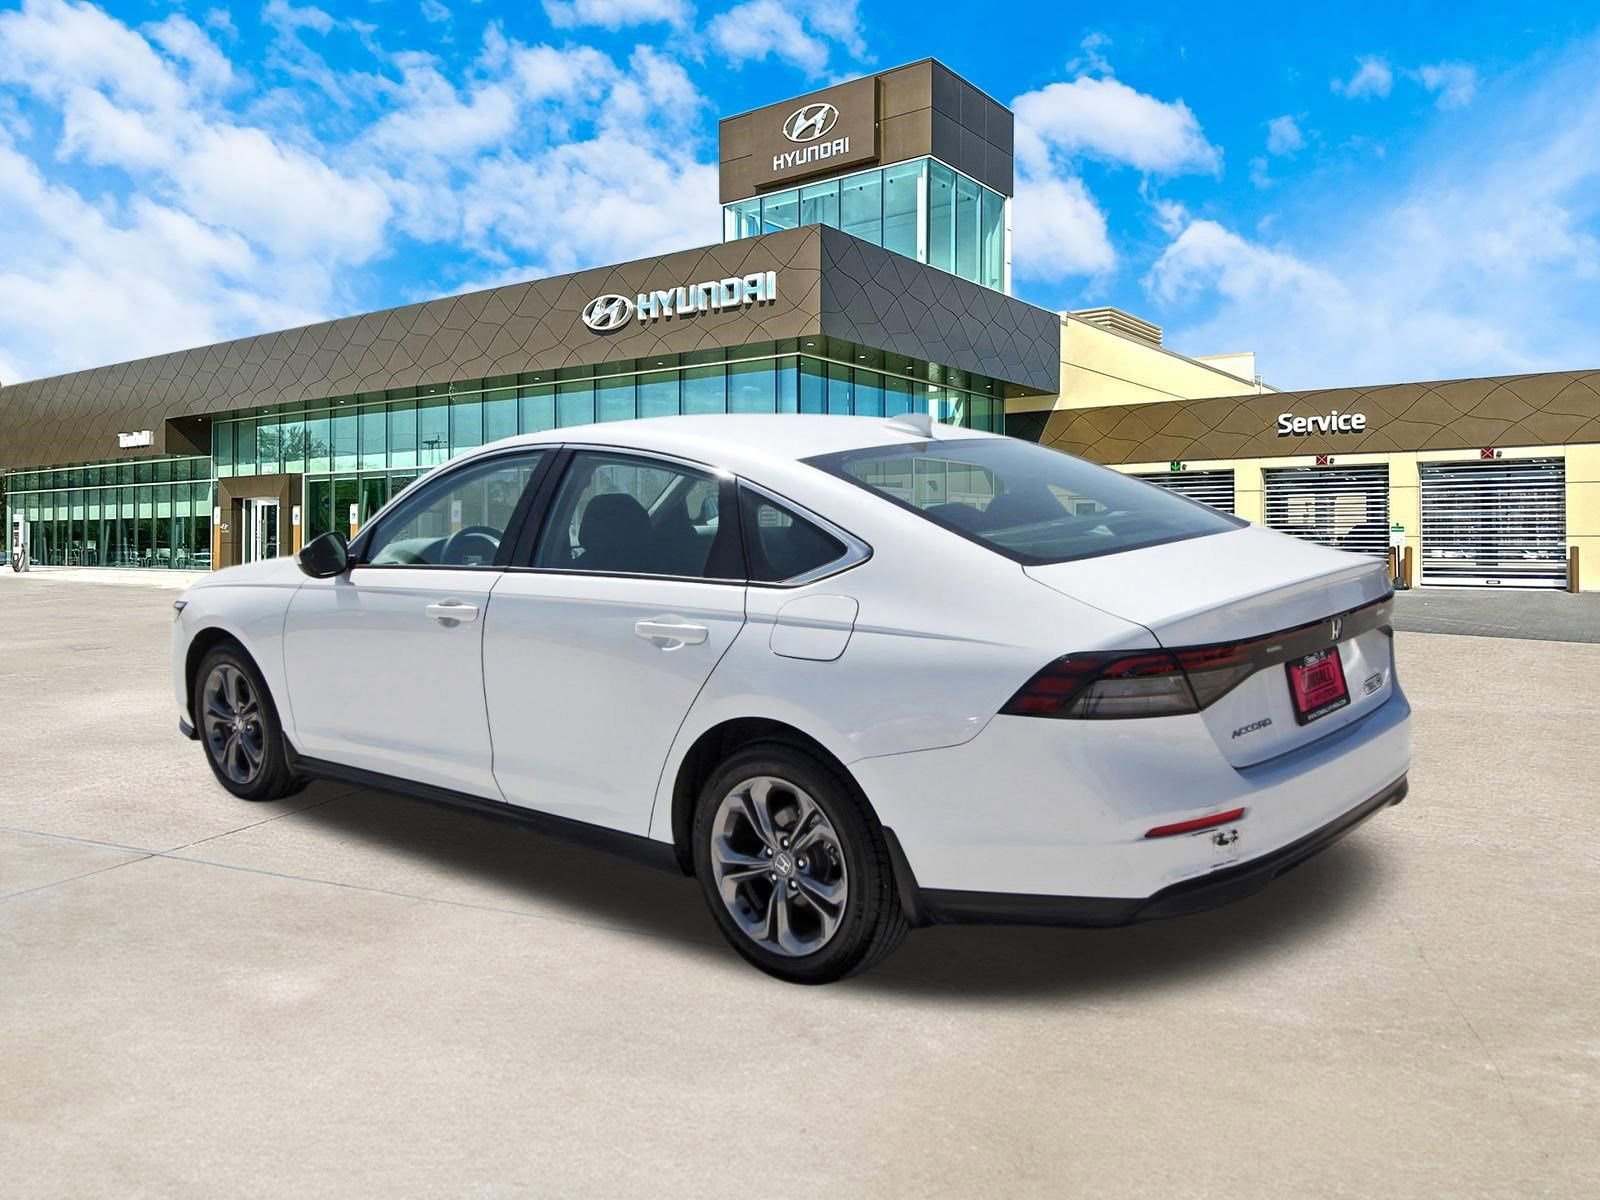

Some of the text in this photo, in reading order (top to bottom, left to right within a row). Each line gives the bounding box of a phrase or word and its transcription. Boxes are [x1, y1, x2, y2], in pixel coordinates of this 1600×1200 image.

[773, 137, 850, 171] HYUNDAI
[637, 271, 777, 322] HYUNDAI
[1278, 410, 1366, 435] Service
[1231, 718, 1272, 739] ACCORD
